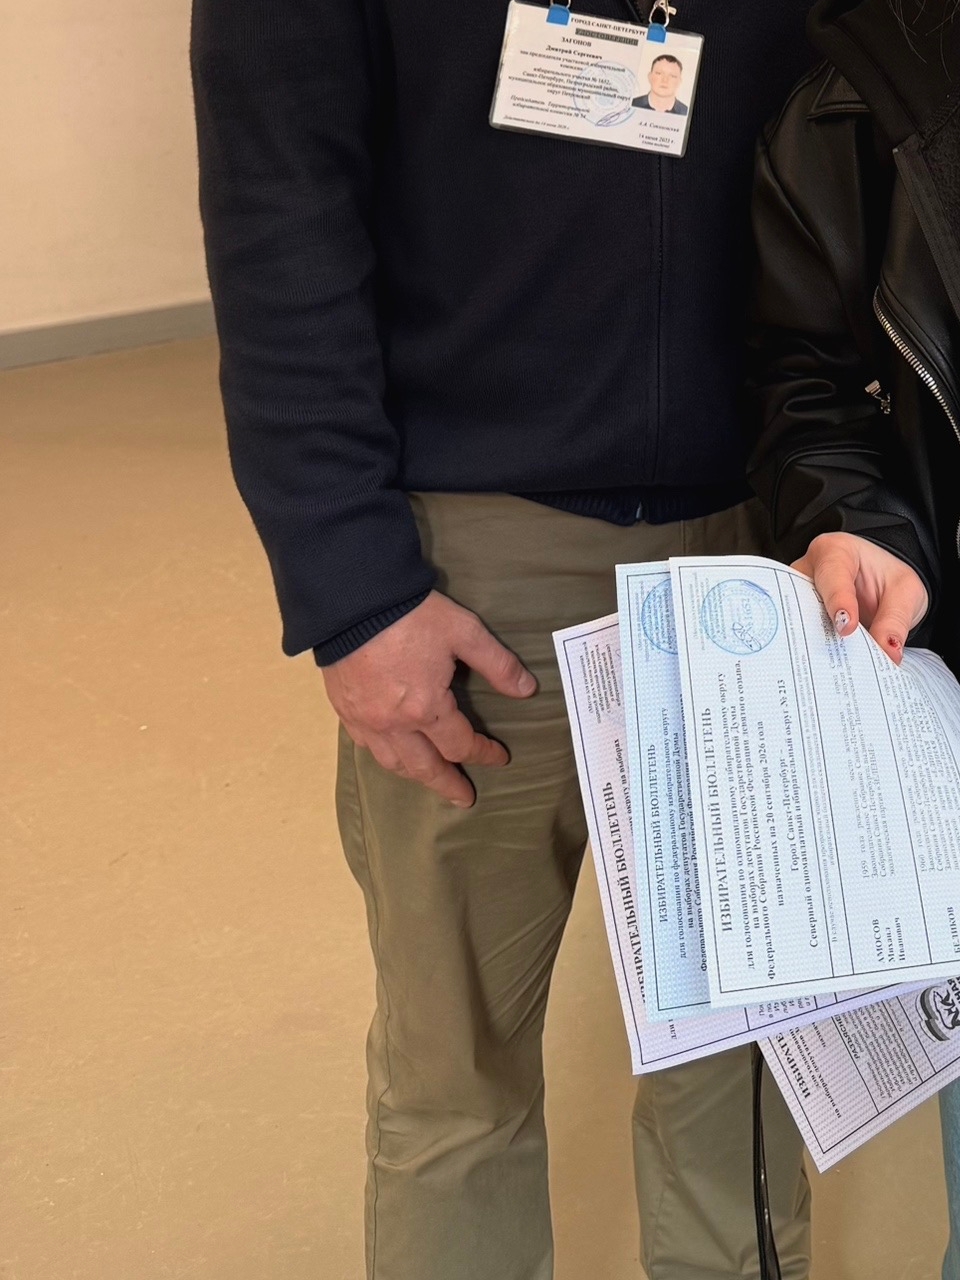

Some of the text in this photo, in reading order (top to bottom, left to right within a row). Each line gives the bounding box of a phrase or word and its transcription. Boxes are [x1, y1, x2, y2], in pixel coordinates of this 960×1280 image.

[570, 17, 591, 25] ГОРОД
[716, 671, 727, 703] округу
[777, 679, 785, 693] 213
[779, 696, 787, 707] №
[670, 732, 681, 757] Думы
[719, 705, 736, 782] избирательному
[782, 709, 793, 735] округ
[741, 739, 756, 791] Федерации
[784, 736, 802, 810] избирательный
[672, 758, 687, 830] Государственной
[728, 704, 760, 928] на выборах депутатов Государственной Думы
[757, 720, 784, 905] назначенных на 20 сентября 2026 года
[777, 756, 797, 840] Санкт-Петербург
[646, 744, 668, 922] ИЗБИРАТЕЛЬНЫЙ БЮЛЛЕТЕНЬ
[661, 706, 688, 958] для голосования по федеральному избирательному округу
[700, 707, 733, 931] ИЗБИРАТЕЛЬНЫЙ БЮЛЛЕТЕНЬ
[747, 800, 760, 850] Российской
[680, 832, 691, 875] депутатов
[738, 868, 744, 880] по
[787, 842, 800, 871] Город
[601, 781, 645, 1002] БИРАТЕЛЬНЫЙ БЮЛЛЕТЕНЬ
[682, 877, 695, 915] выборах
[753, 853, 768, 903] Собрания
[688, 917, 694, 928] на
[739, 883, 752, 947] голосования
[804, 894, 820, 947] Северный
[946, 906, 960, 953] БЕЛИКОВ
[747, 950, 756, 969] для
[760, 905, 777, 979] Федерального
[871, 918, 885, 963] АМОСОВ
[883, 926, 895, 962] Михаил
[892, 916, 905, 961] Иванович
[811, 1021, 826, 1047] назнач
[833, 1013, 860, 1059] РАЗЪЯСНЕ
[774, 1031, 811, 1098] ИЗБИРАТЕ
[816, 1073, 837, 1107] выборах
